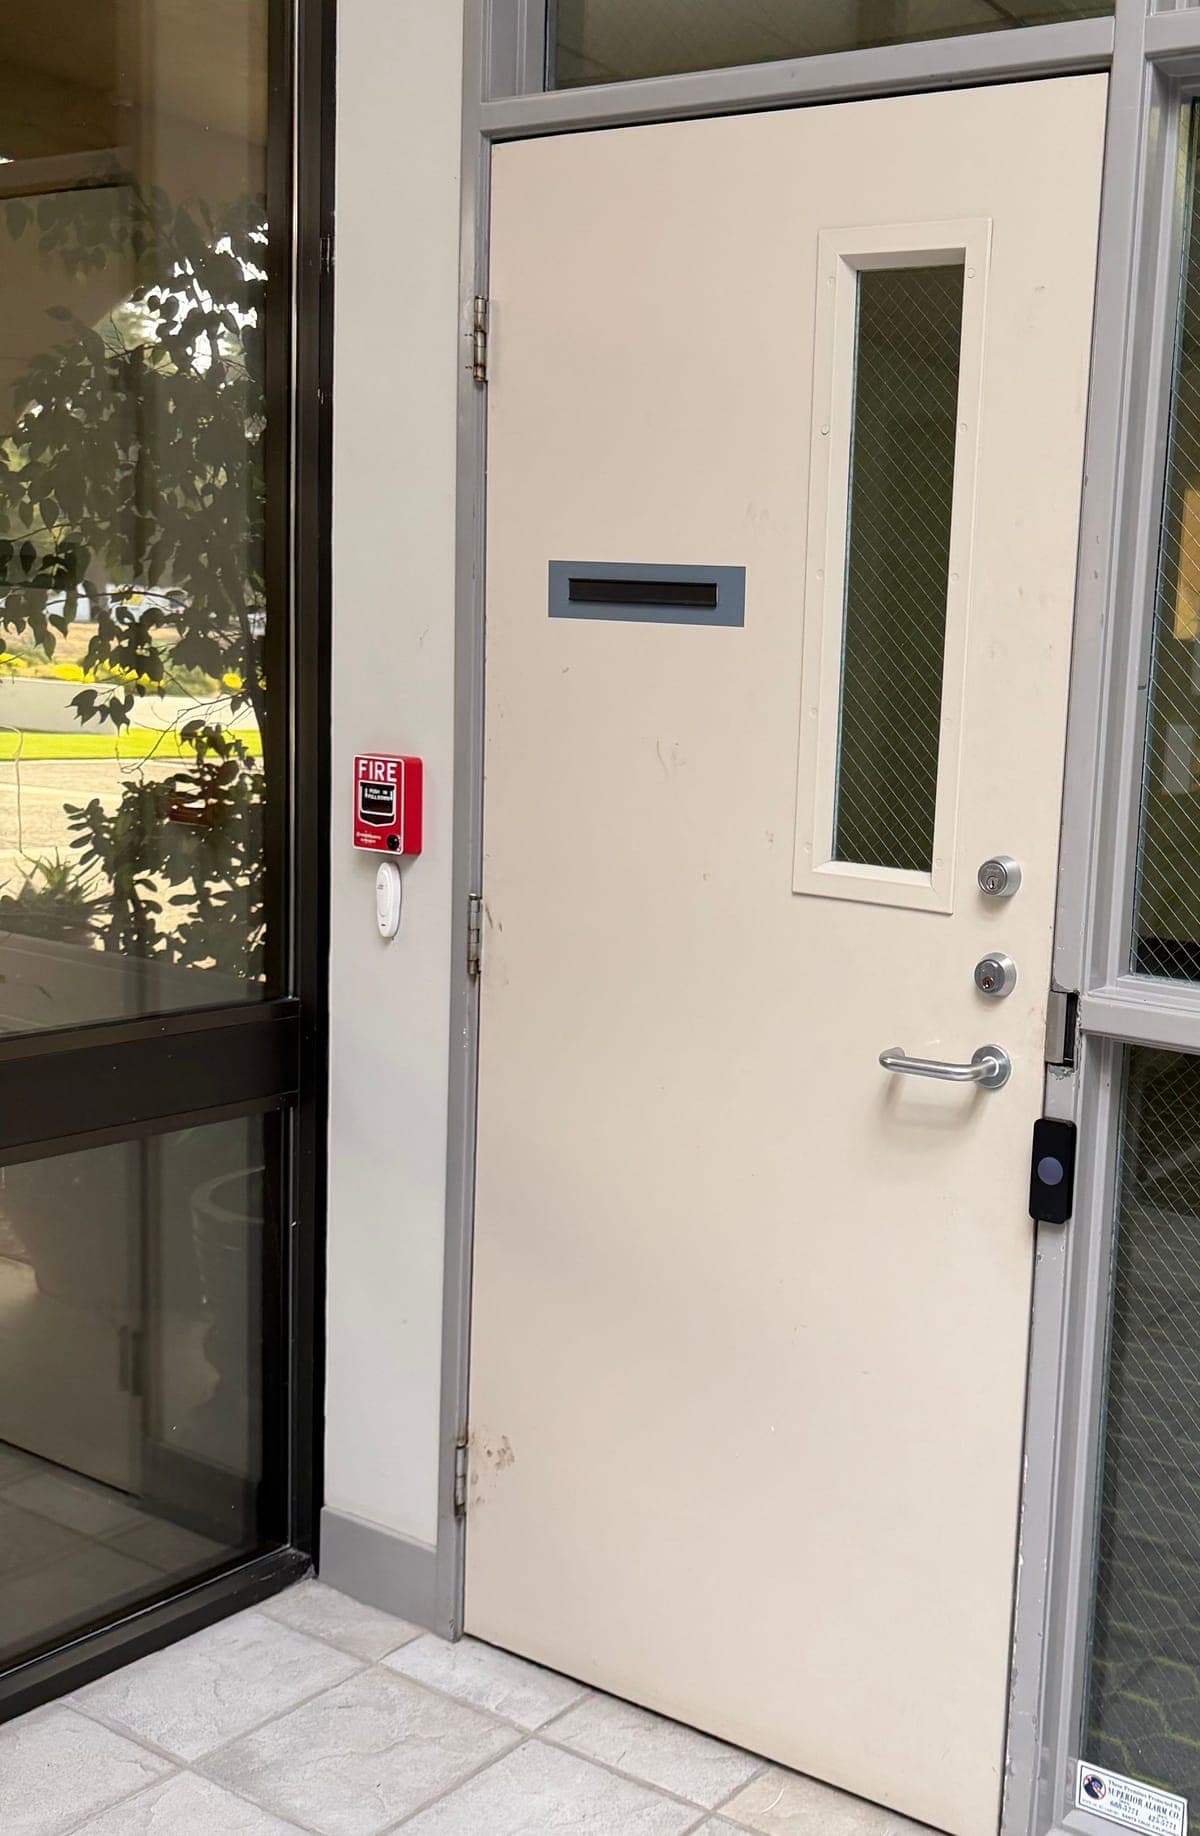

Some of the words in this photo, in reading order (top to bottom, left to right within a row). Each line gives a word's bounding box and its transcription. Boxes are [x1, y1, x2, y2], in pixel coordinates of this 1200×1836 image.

[359, 760, 397, 782] FIRE
[1108, 1787, 1142, 1807] SUPERIOR
[1145, 1801, 1167, 1815] ALARM
[1168, 1809, 1181, 1821] CO.
